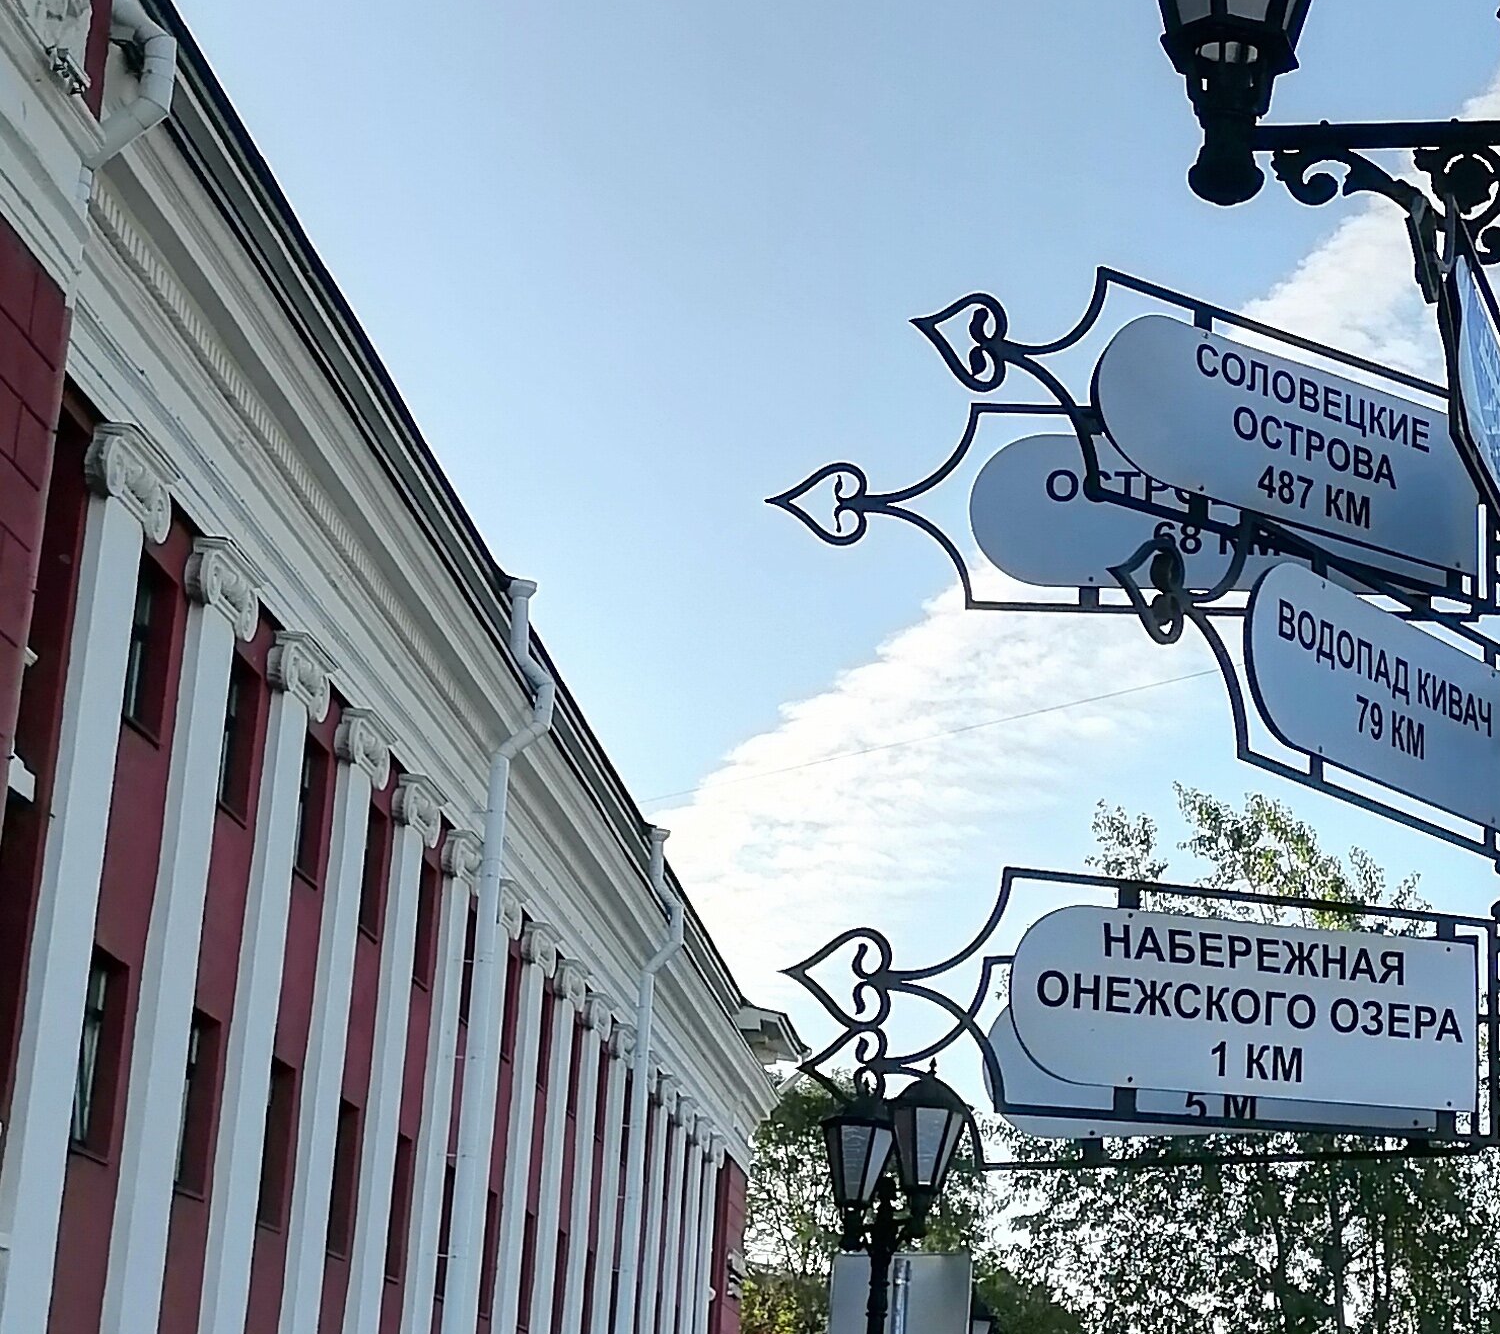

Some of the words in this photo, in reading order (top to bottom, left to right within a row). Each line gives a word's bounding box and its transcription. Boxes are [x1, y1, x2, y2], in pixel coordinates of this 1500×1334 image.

[1197, 344, 1429, 453] СОЛОВЕЦКИЕ
[1234, 407, 1396, 489] ОСТРОВА
[1046, 469, 1240, 507] ОСТР
[1258, 466, 1313, 509] 487
[1326, 484, 1370, 529] КМ
[1153, 521, 1202, 555] 68
[1279, 599, 1409, 705] ВОДОПАД
[1418, 668, 1491, 737] КИВАЧ
[1357, 694, 1382, 740] 79
[1392, 711, 1424, 760] КМ
[1104, 923, 1403, 985] НАБЕРЕЖНАЯ
[1037, 971, 1315, 1029] ОНЕЖСКОГО
[1331, 998, 1462, 1043] ОЗЕРА
[1212, 1042, 1226, 1076] 1
[1247, 1044, 1302, 1082] КМ
